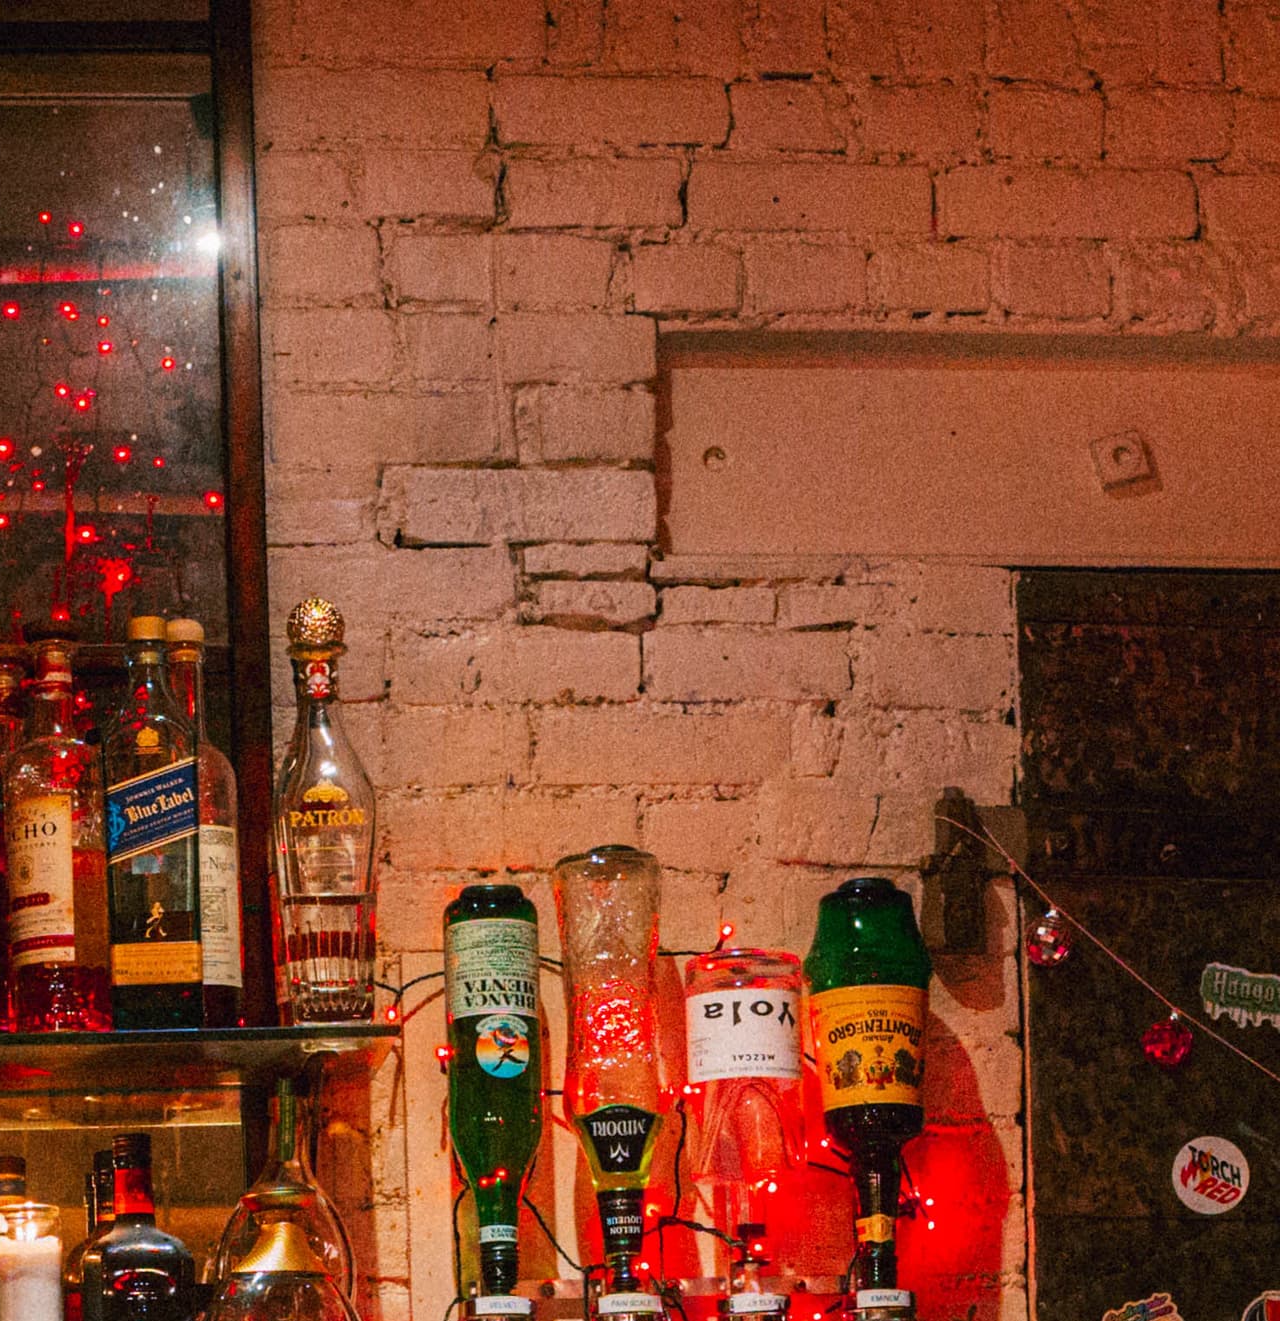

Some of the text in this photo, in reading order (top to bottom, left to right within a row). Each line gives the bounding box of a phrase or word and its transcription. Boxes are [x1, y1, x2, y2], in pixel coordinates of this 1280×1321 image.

[124, 801, 160, 824] Blue
[156, 787, 194, 813] Label
[290, 806, 365, 827] PATRÓN
[464, 994, 536, 1010] BRANCA
[704, 1001, 795, 1028] Yola
[590, 1119, 645, 1137] MIDORI
[1188, 1144, 1242, 1187] TORCH
[1194, 1177, 1241, 1205] RED
[606, 1216, 643, 1226] LIQUEUR
[610, 1225, 640, 1234] MELON
